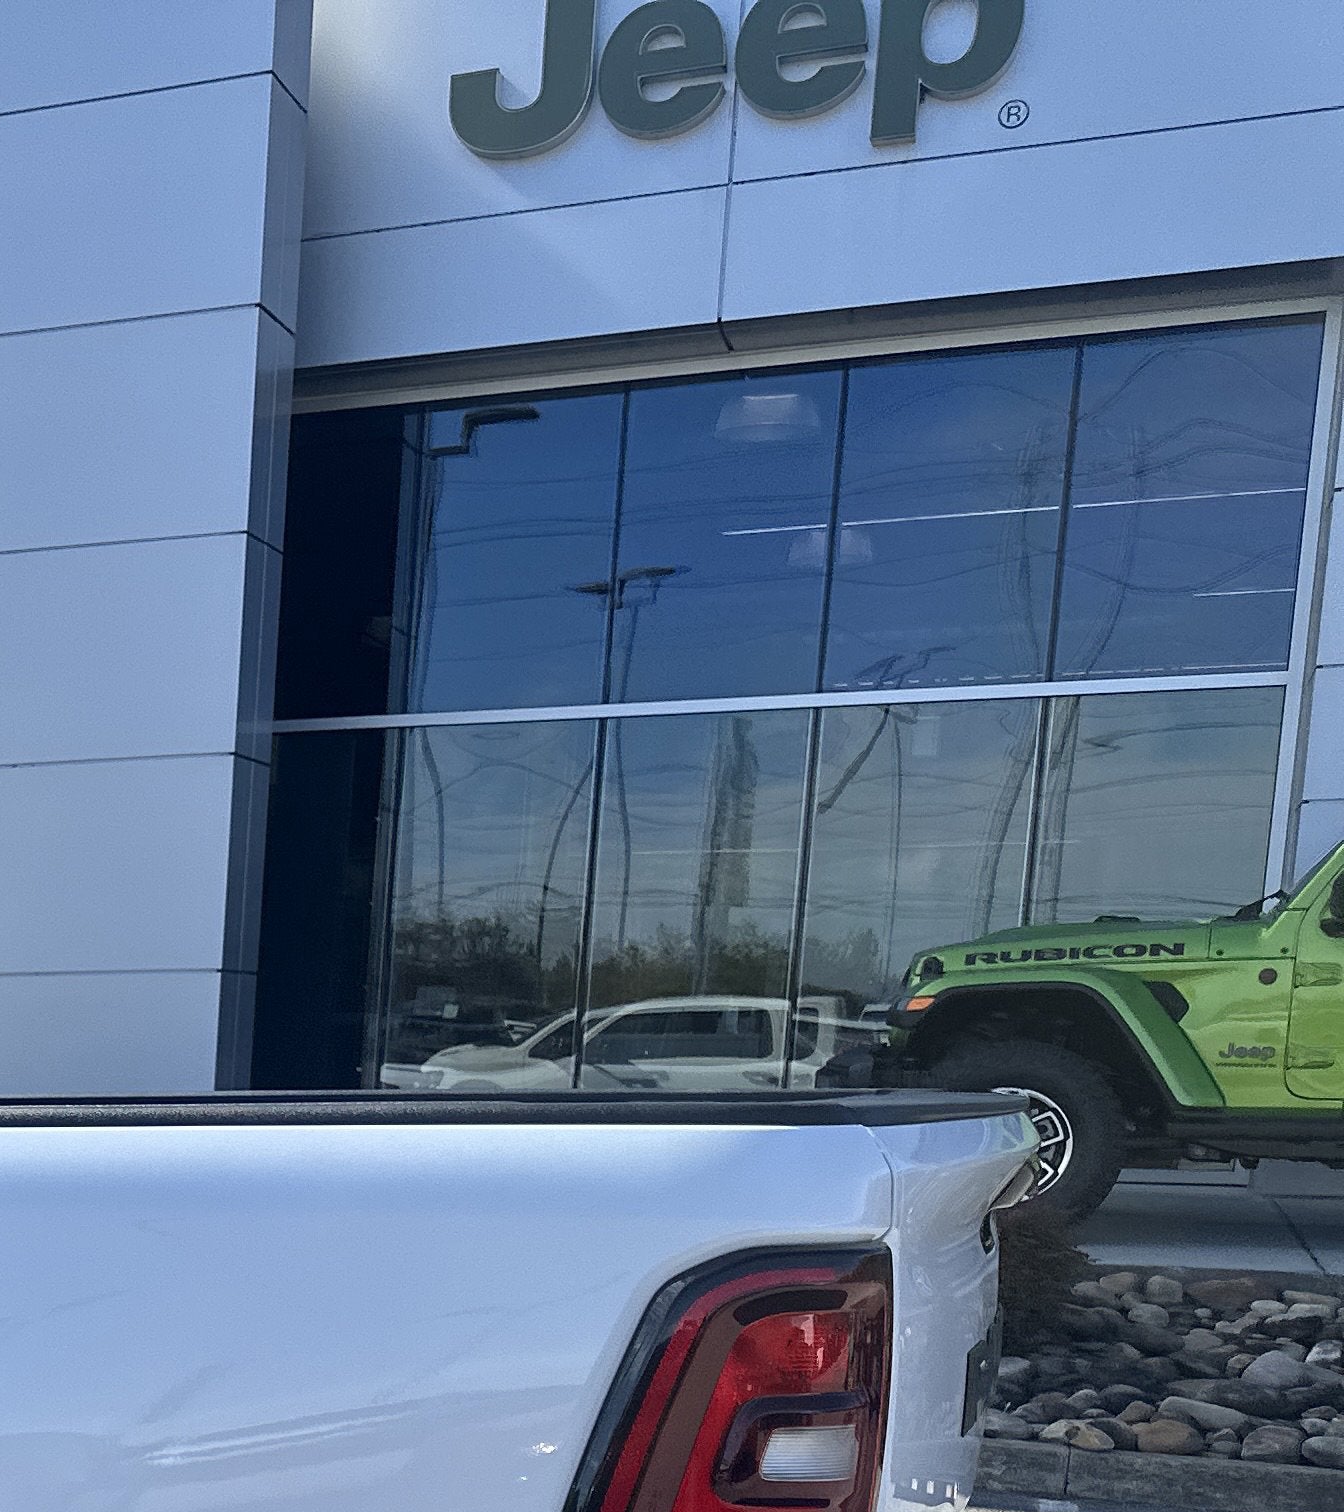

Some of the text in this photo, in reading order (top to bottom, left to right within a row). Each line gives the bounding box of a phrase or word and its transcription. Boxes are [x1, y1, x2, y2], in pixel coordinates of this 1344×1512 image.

[450, 0, 1024, 160] Jeep
[964, 942, 1185, 966] RUBICON
[1218, 1042, 1276, 1062] Jeep
